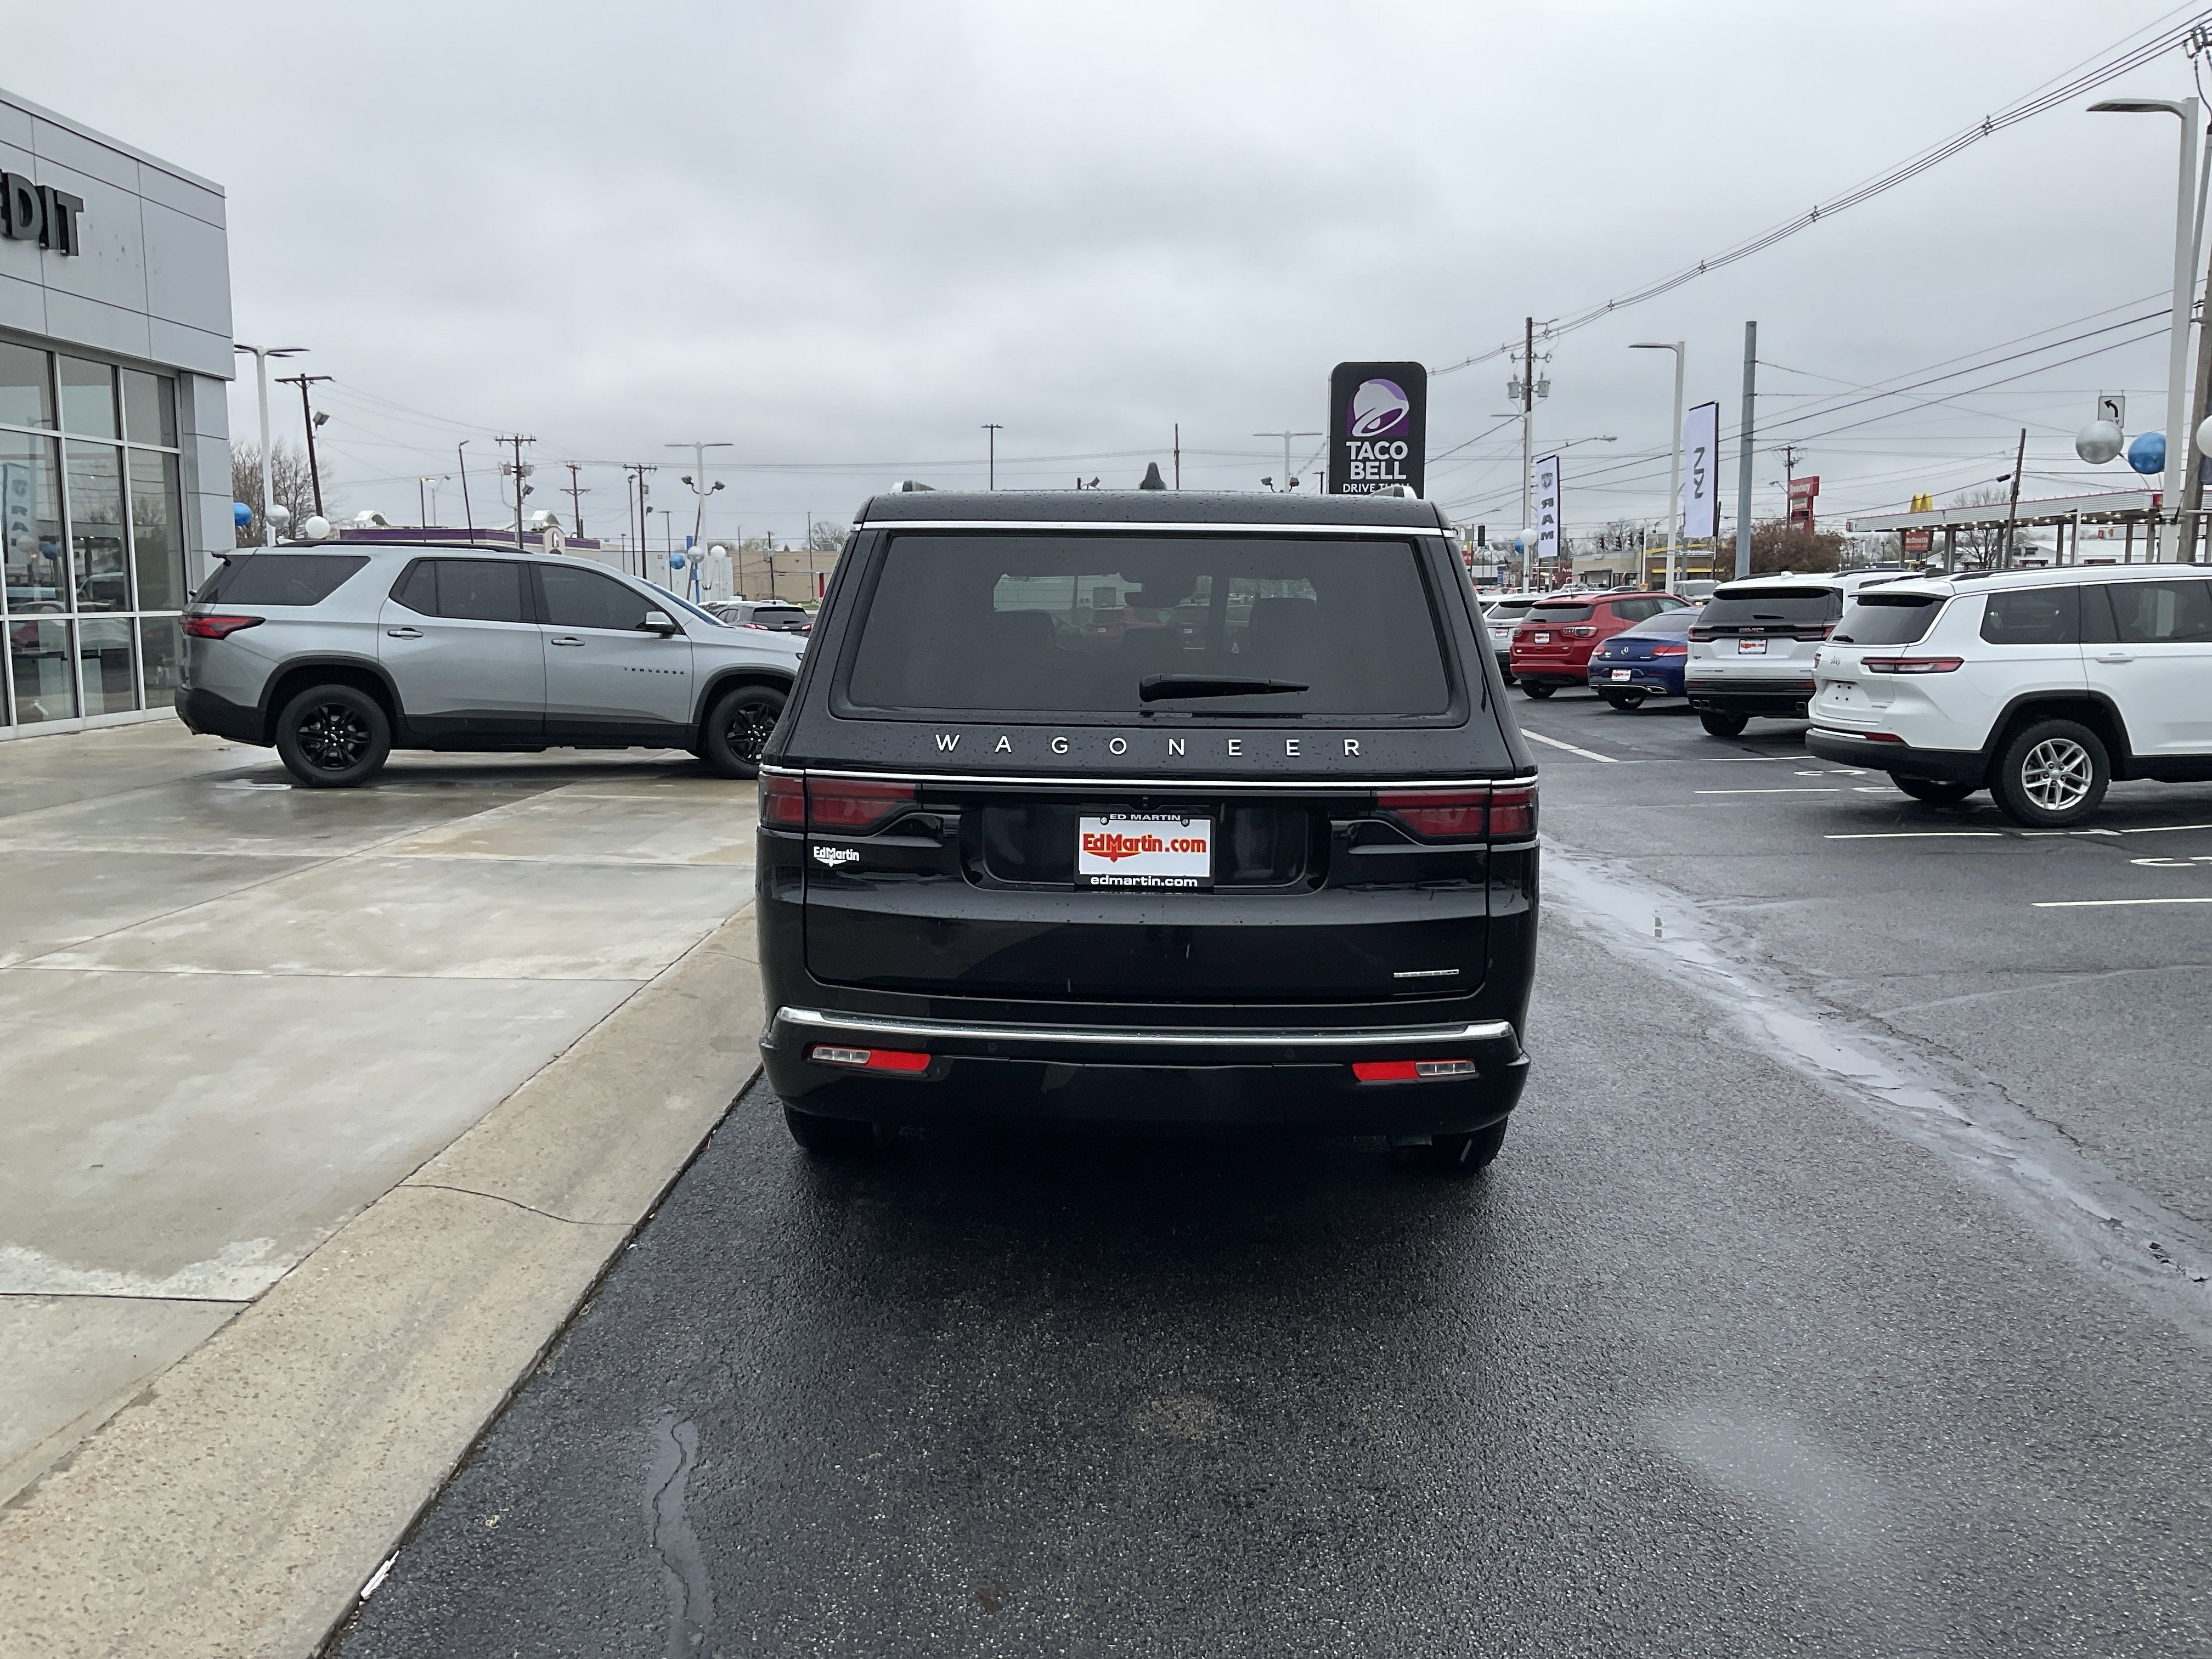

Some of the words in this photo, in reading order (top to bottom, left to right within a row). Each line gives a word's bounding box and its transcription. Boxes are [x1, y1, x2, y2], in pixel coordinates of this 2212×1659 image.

[0, 168, 84, 256] DIT
[1346, 441, 1408, 460] TACO
[1350, 461, 1407, 479] BELL
[1342, 483, 1376, 493] DRIVE
[935, 734, 1359, 755] WAGONEER
[1083, 833, 1206, 854] EdMartin.com
[814, 847, 860, 861] EdMartin
[1091, 875, 1198, 887] edmartin.com
